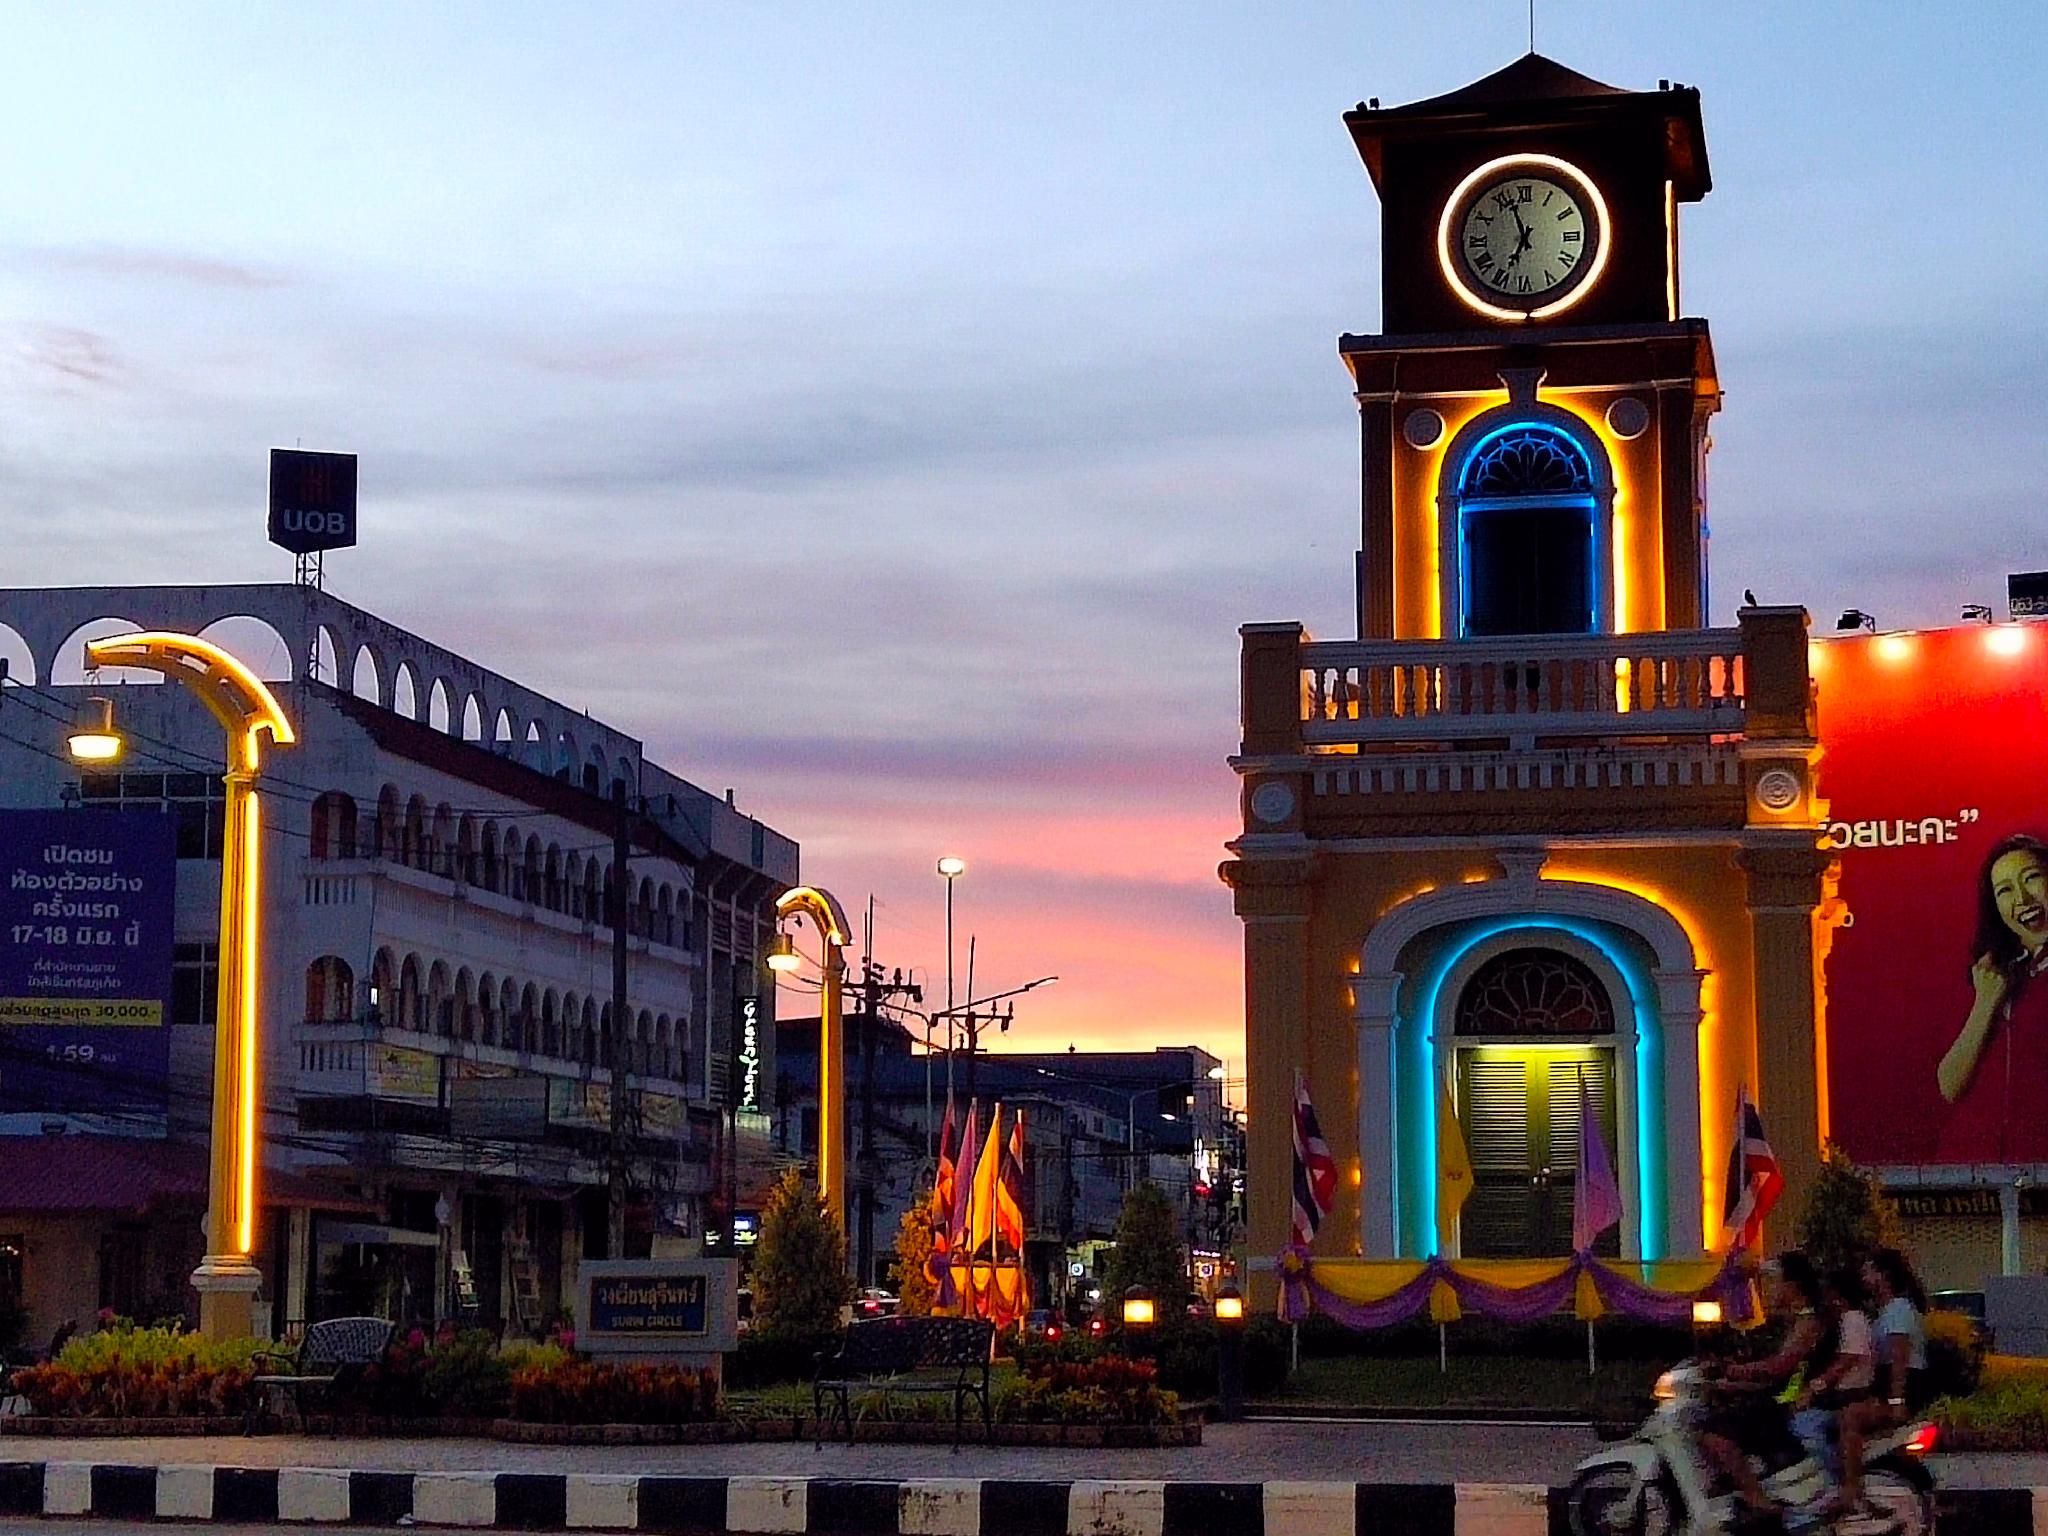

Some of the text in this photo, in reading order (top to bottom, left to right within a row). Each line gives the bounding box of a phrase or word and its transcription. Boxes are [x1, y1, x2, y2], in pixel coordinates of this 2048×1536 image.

[1516, 185, 1533, 203] XII
[1557, 206, 1574, 221] II
[1563, 231, 1580, 242] III
[283, 508, 345, 534] UOB
[1826, 809, 1979, 850] วยนะคะ”
[44, 845, 113, 864] เปิดชม
[11, 868, 143, 891] ห้องตัวอย่าง
[33, 891, 119, 918] ครั้งแรก
[11, 920, 140, 945] 17-18 มิ.ย. นี้
[647, 1314, 683, 1328] CIRCLE
